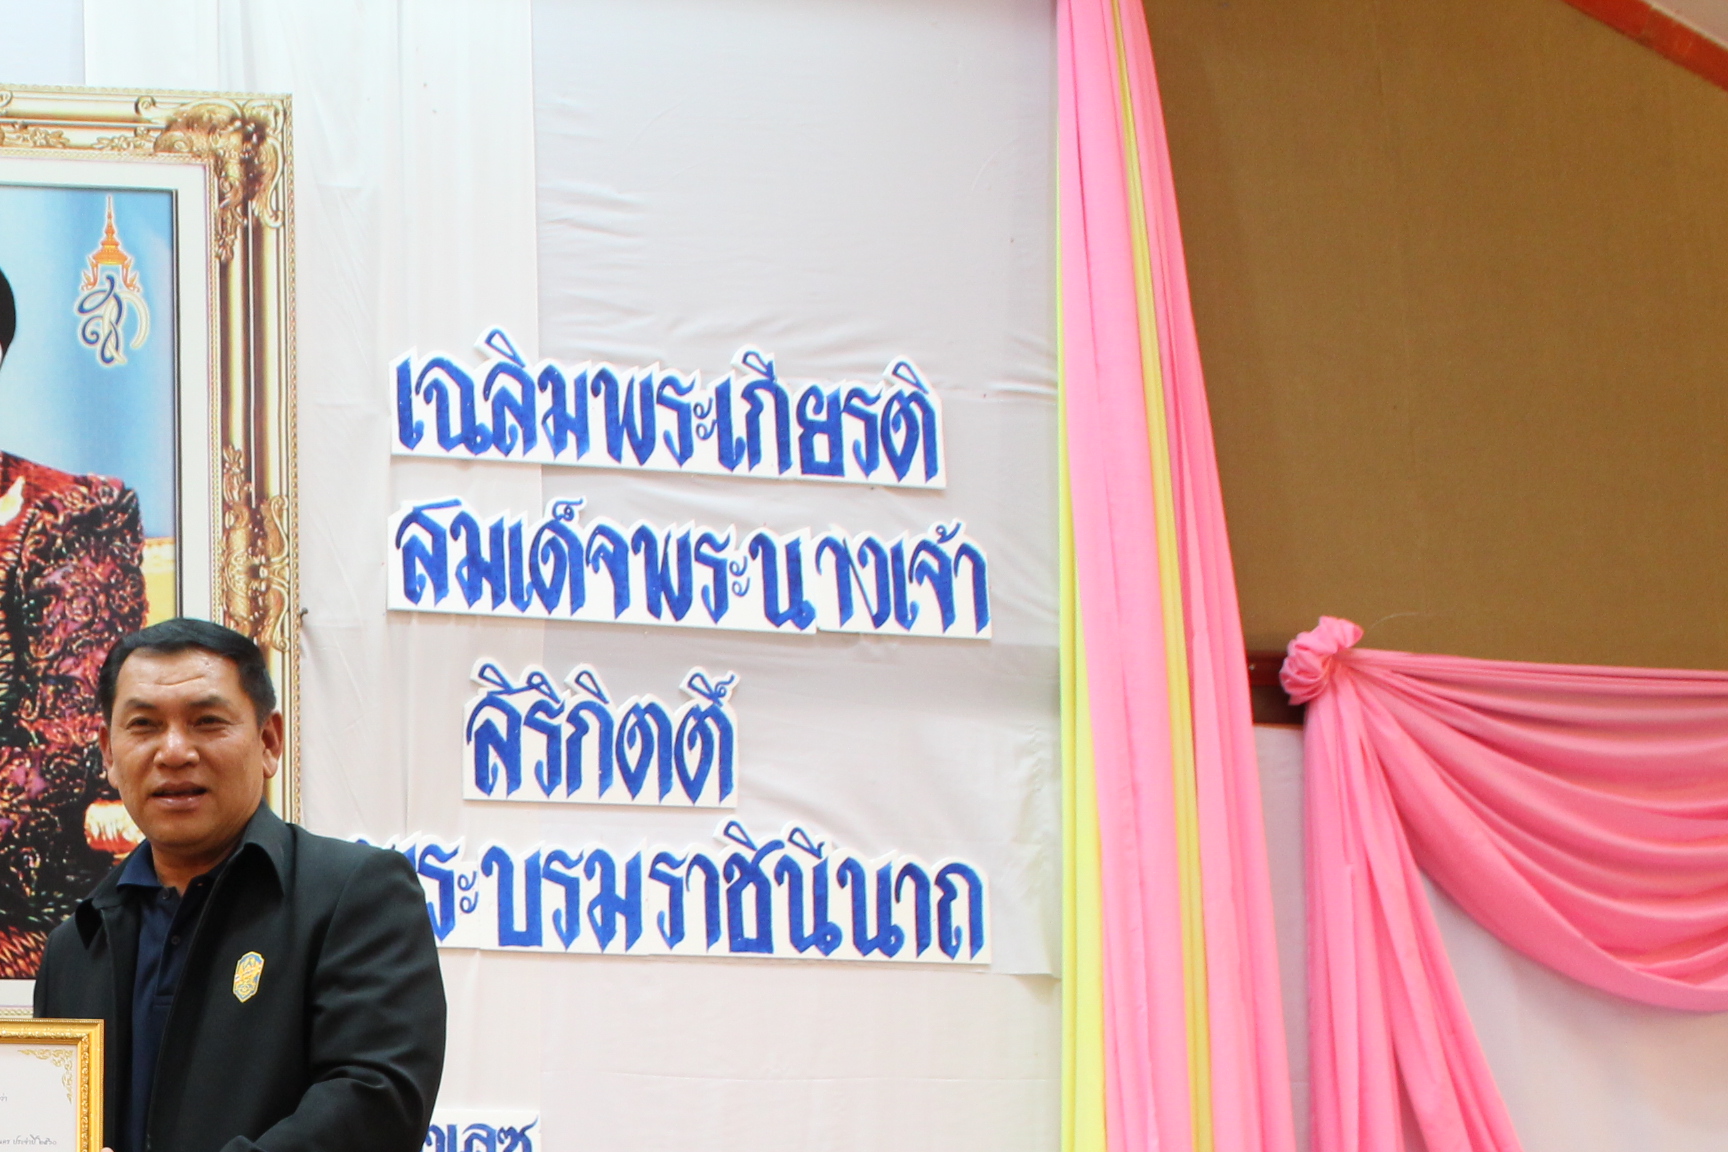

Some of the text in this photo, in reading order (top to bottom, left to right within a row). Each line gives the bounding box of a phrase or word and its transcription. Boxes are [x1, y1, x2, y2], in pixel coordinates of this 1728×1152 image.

[396, 327, 940, 482] เฉลิมพระเกียรติ
[396, 498, 990, 633] สมเด็จพระนางเจ้า
[466, 662, 736, 804] สิริกิตติ์
[362, 816, 986, 959] ระบรมราชินีนาถ
